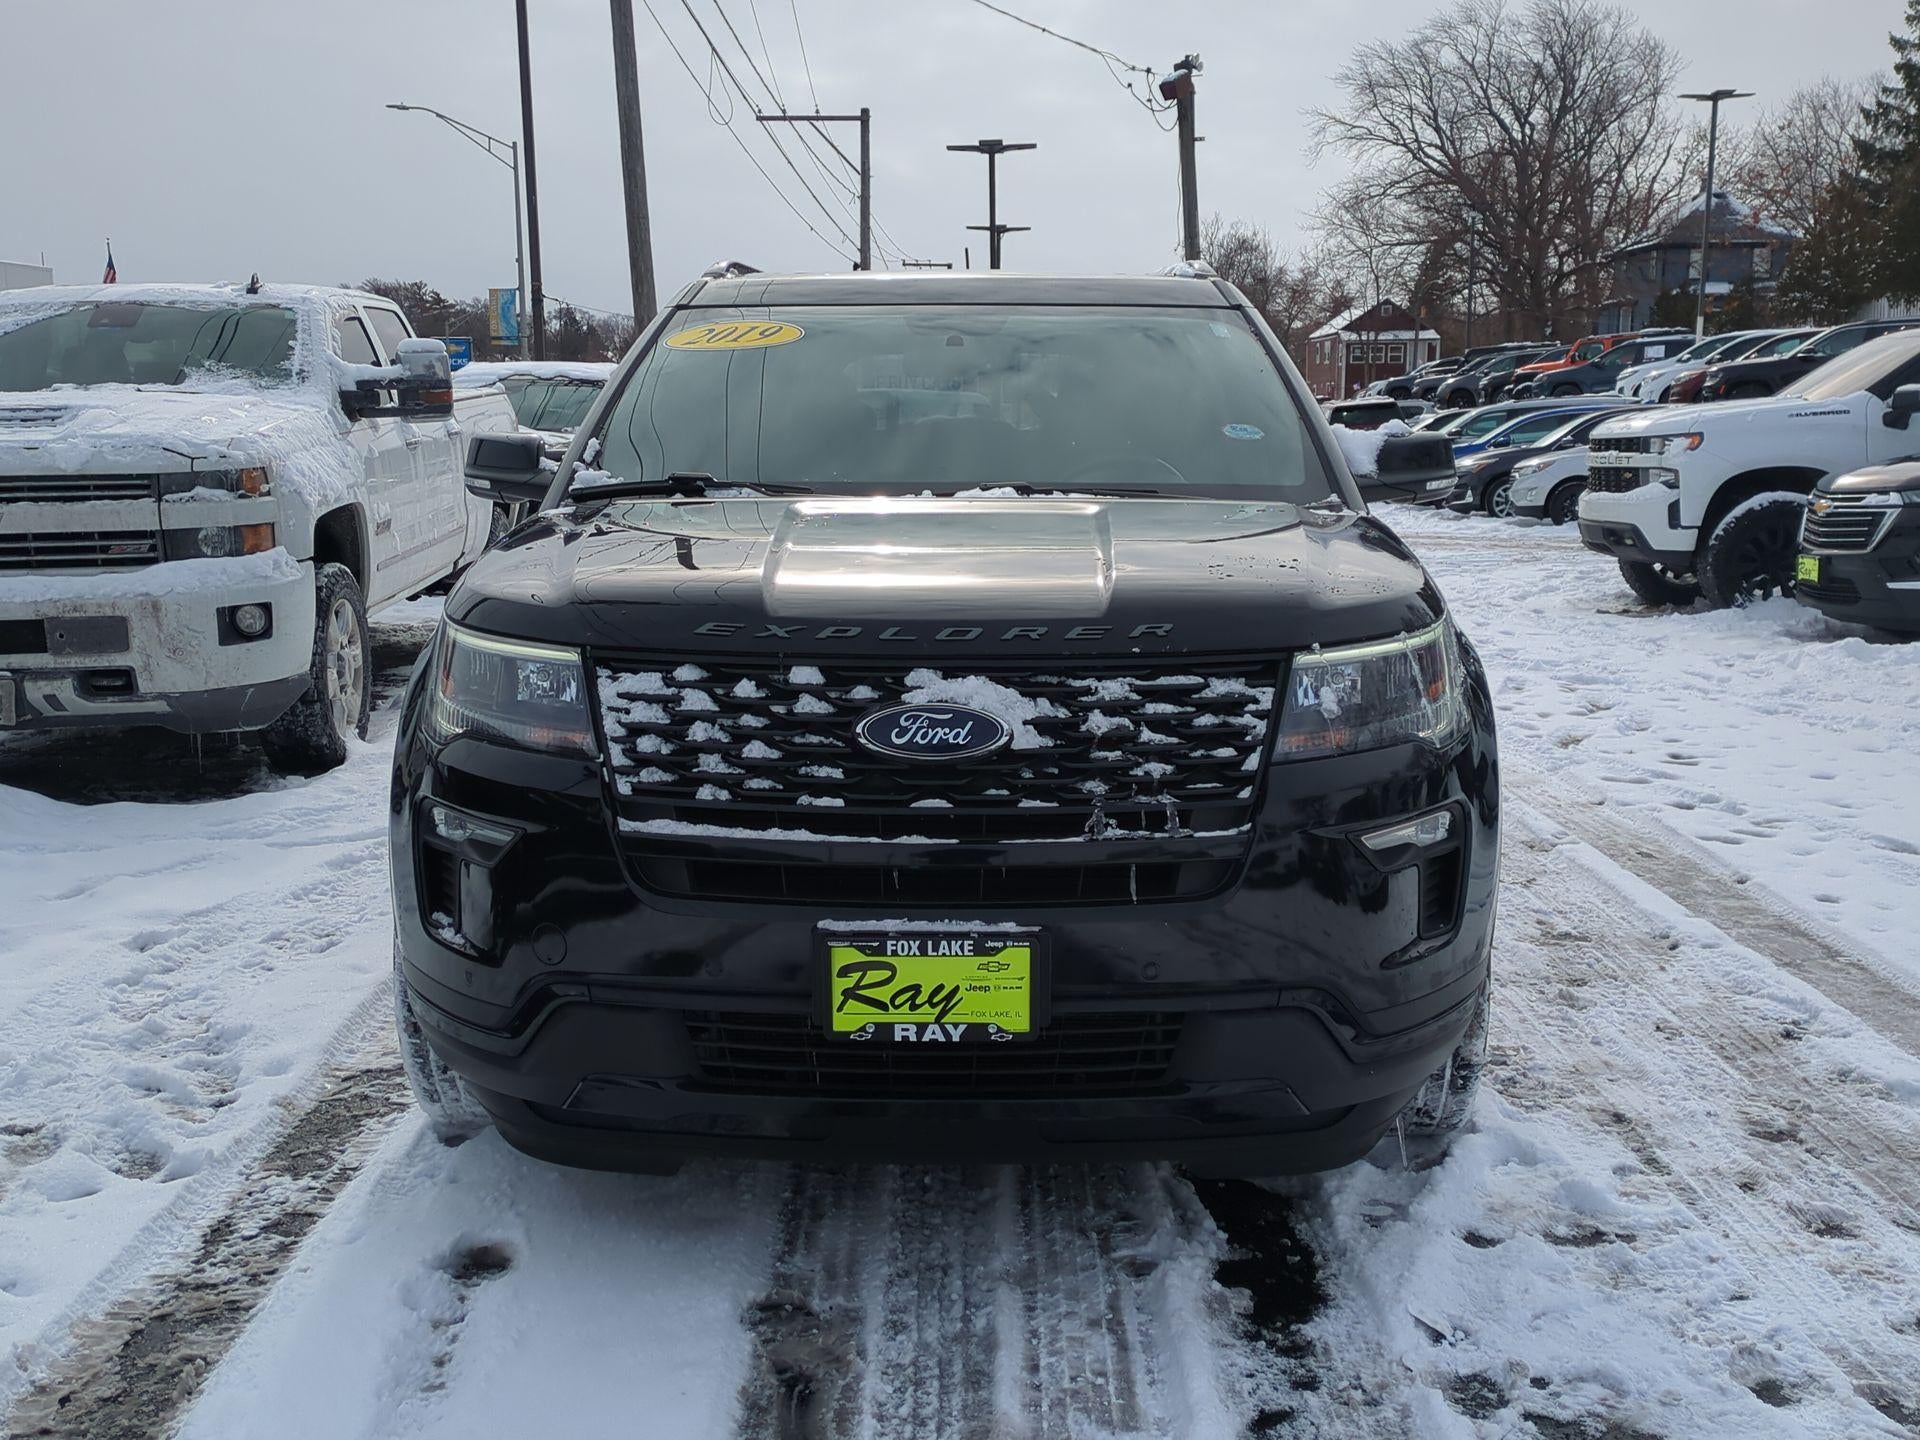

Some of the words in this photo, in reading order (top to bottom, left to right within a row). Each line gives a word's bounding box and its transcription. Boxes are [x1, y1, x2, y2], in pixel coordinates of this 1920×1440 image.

[680, 325, 784, 346] 2019
[692, 622, 1175, 641] EXPLORER
[891, 711, 974, 746] Ford
[886, 940, 920, 956] FOX
[927, 940, 974, 956] LAKE
[984, 940, 1004, 949] Jeep
[836, 960, 964, 1023] Ray
[965, 983, 991, 994] Jeep
[970, 1010, 987, 1018] FOX
[989, 1010, 1013, 1019] LAKE,
[1015, 1010, 1022, 1018] IL
[894, 1023, 968, 1042] RAY
